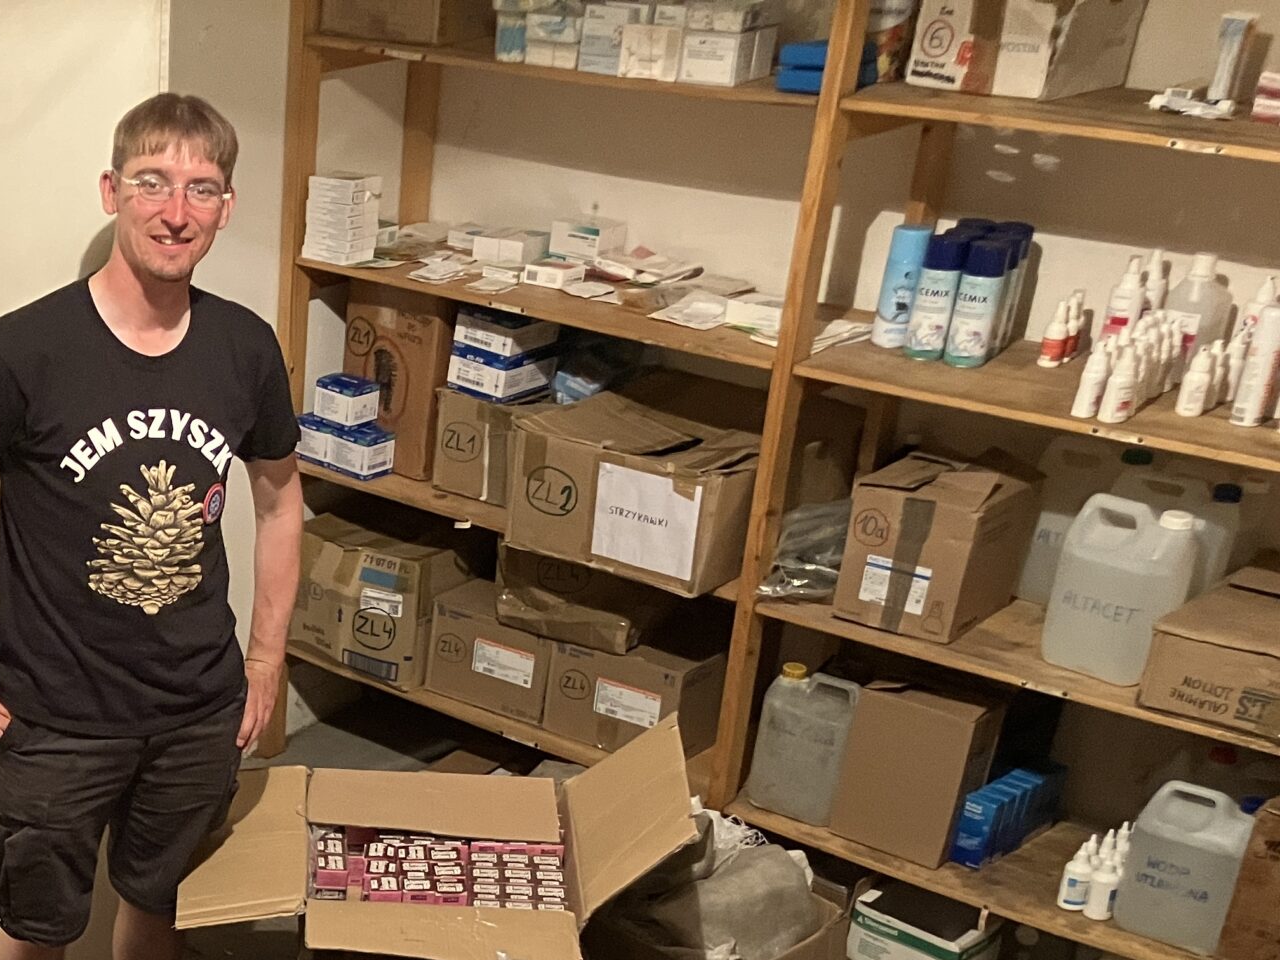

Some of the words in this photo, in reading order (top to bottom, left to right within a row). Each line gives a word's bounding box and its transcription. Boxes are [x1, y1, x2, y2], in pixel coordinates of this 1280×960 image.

[350, 326, 372, 346] ZL1
[59, 417, 124, 483] JEM
[445, 428, 477, 454] ZL1
[607, 505, 670, 528] STRZYKAWKI
[354, 614, 393, 641] ZL4
[439, 639, 462, 658] ZL4
[562, 674, 587, 693] ZL4
